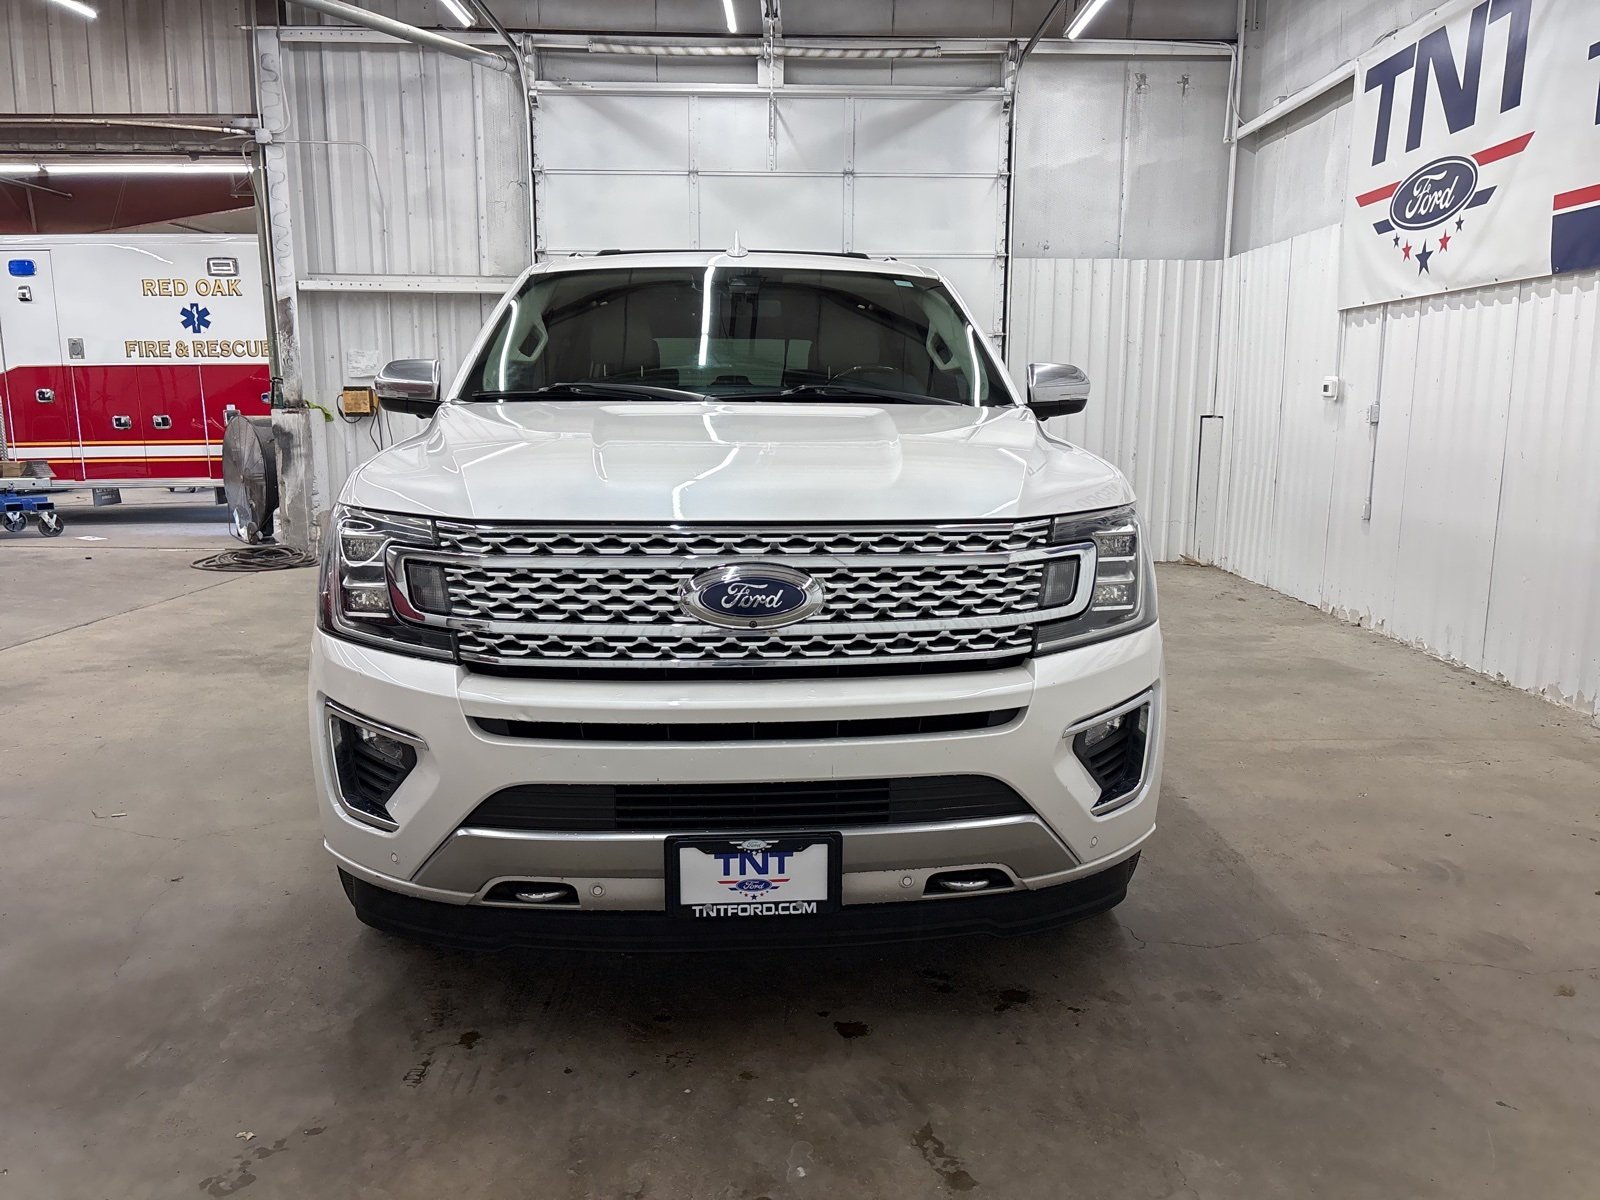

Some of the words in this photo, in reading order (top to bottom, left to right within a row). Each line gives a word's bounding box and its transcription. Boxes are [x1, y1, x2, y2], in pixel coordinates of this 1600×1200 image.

[1364, 0, 1532, 167] TNT
[1405, 170, 1460, 219] Ford
[141, 278, 189, 297] RED
[195, 278, 243, 297] OAK
[125, 340, 172, 358] FIRE
[175, 340, 190, 357] &
[721, 582, 784, 609] Ford
[714, 851, 793, 876] TNT
[742, 881, 765, 890] Ford
[692, 902, 817, 917] TNTFORD.COM
